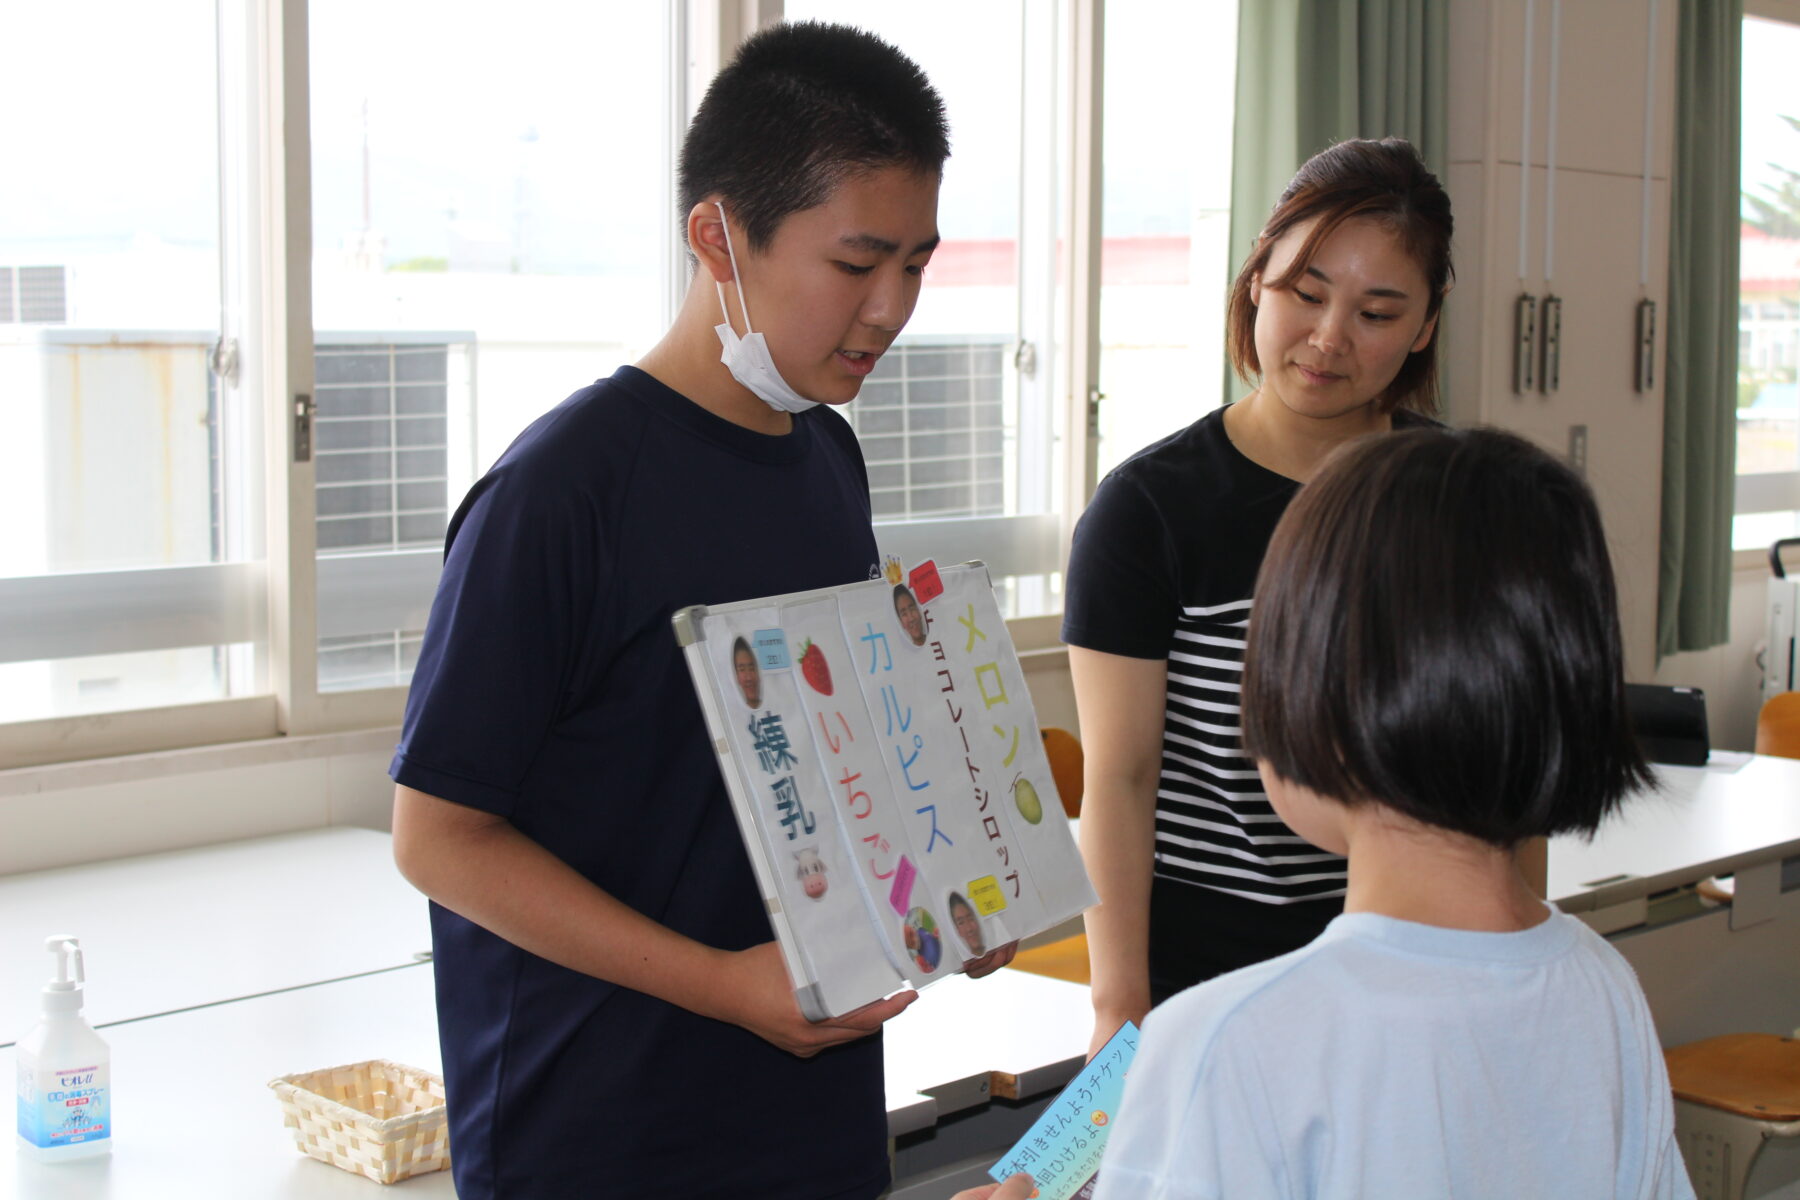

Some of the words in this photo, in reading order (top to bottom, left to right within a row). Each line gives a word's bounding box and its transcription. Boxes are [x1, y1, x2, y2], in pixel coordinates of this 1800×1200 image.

[860, 622, 954, 854] カルピス
[957, 603, 1020, 769] メロン
[748, 710, 818, 841] 練乳
[817, 711, 896, 881] いちご
